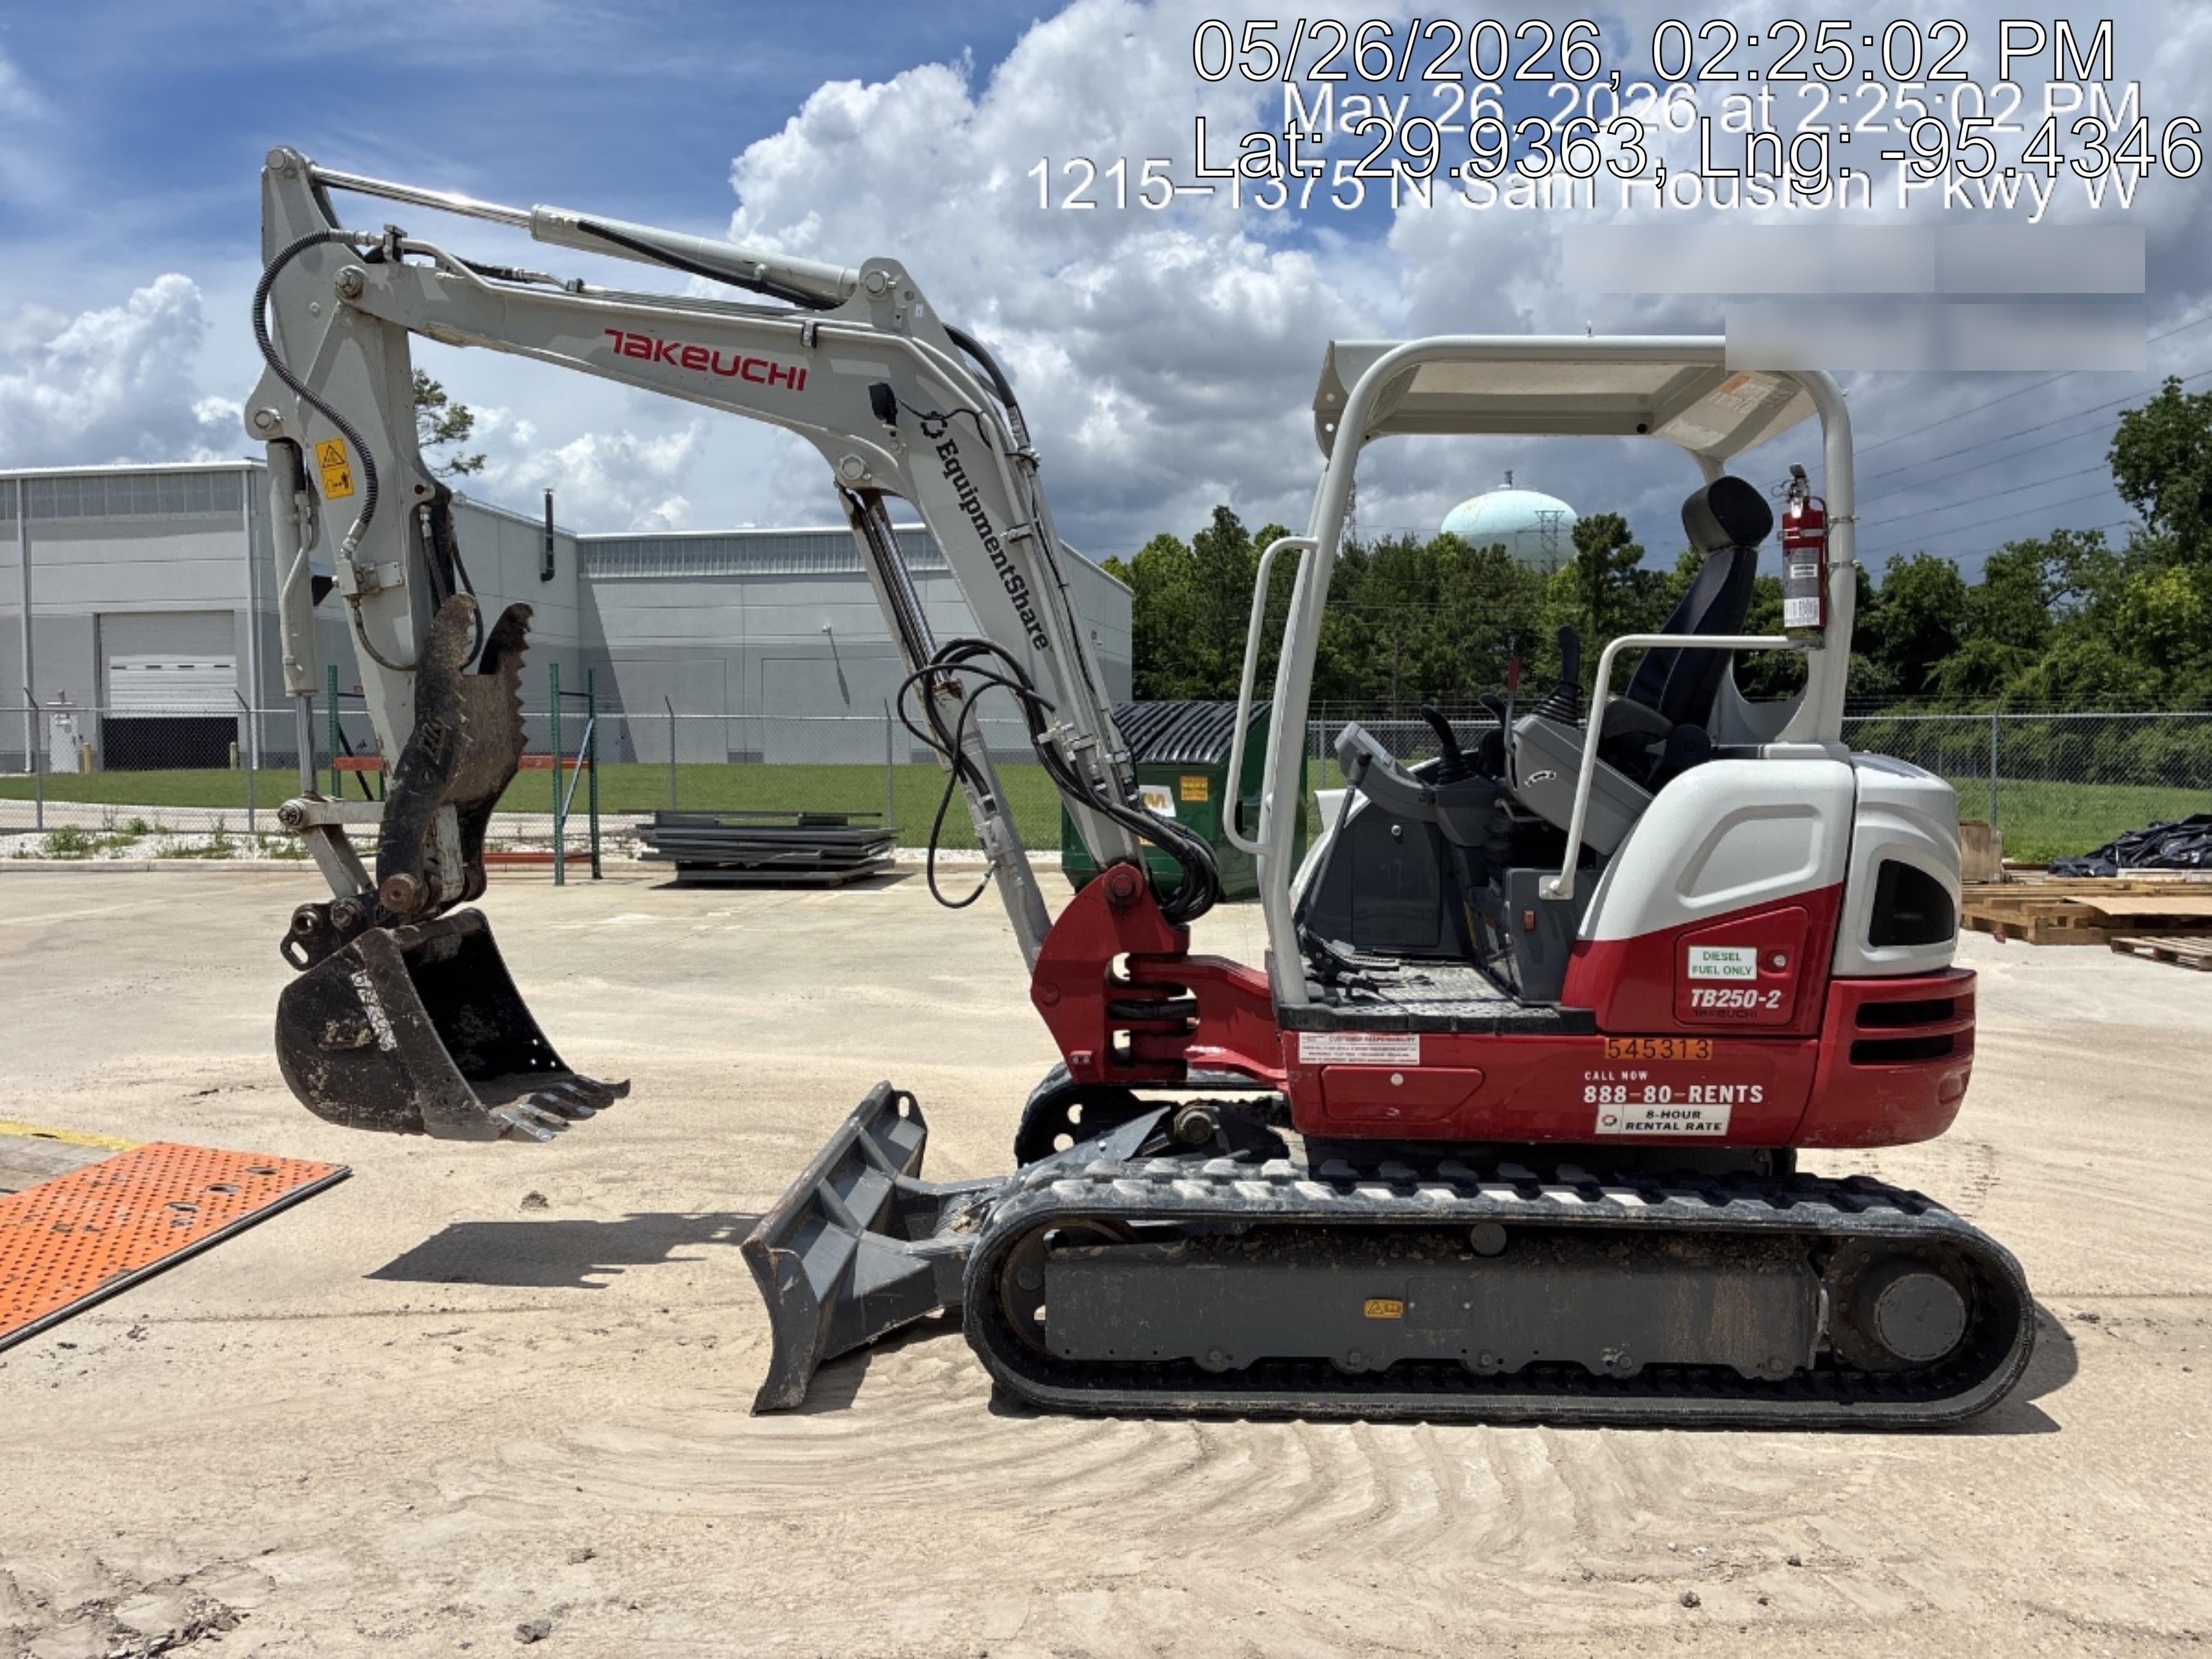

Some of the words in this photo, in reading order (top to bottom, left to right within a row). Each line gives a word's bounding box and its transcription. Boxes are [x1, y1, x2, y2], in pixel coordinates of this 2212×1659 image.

[936, 438, 1049, 651] EquipmentShare
[1703, 951, 1742, 961] DIESEL
[1692, 965, 1720, 975] FUEL
[1722, 965, 1753, 976] ONLY
[1691, 989, 1782, 1009] TB250-2
[1607, 1038, 1710, 1059] 545313
[1584, 1070, 1615, 1081] CALL
[1622, 1070, 1649, 1081] NOW
[1583, 1084, 1764, 1104] 888-80-RENTS
[1645, 1110, 1702, 1120] 8-HOUR
[1625, 1122, 1681, 1131] RENTAL
[1685, 1122, 1722, 1131] RATE
